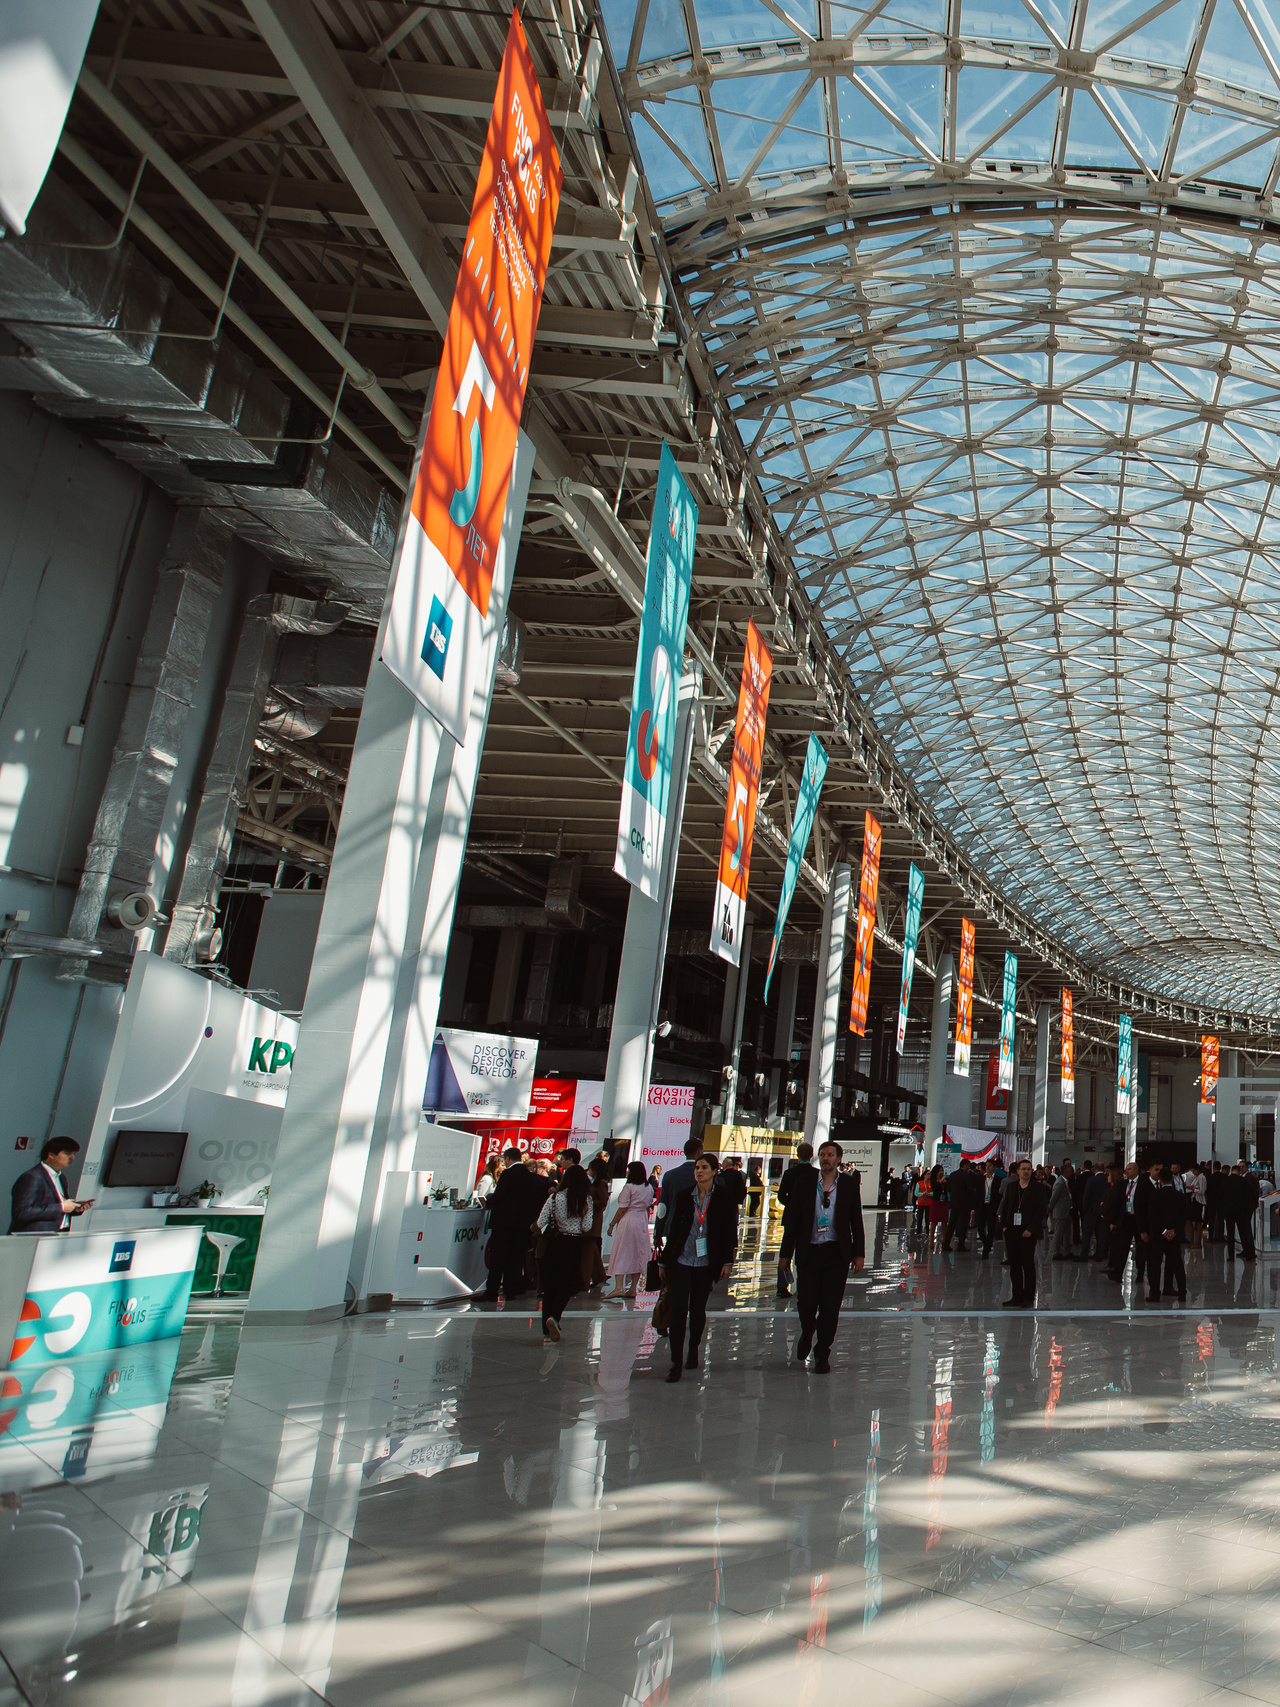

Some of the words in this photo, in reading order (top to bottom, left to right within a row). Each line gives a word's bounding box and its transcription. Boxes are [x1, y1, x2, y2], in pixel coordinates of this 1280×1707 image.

[465, 523, 487, 567] ЛЕТ
[430, 621, 446, 654] IBS
[631, 828, 651, 859] CROC
[248, 1036, 296, 1074] КР
[472, 1056, 515, 1069] DESIGN.
[474, 1045, 528, 1061] DISCOVER.
[470, 1066, 518, 1079] DEVELOP.
[114, 1252, 130, 1262] IBS
